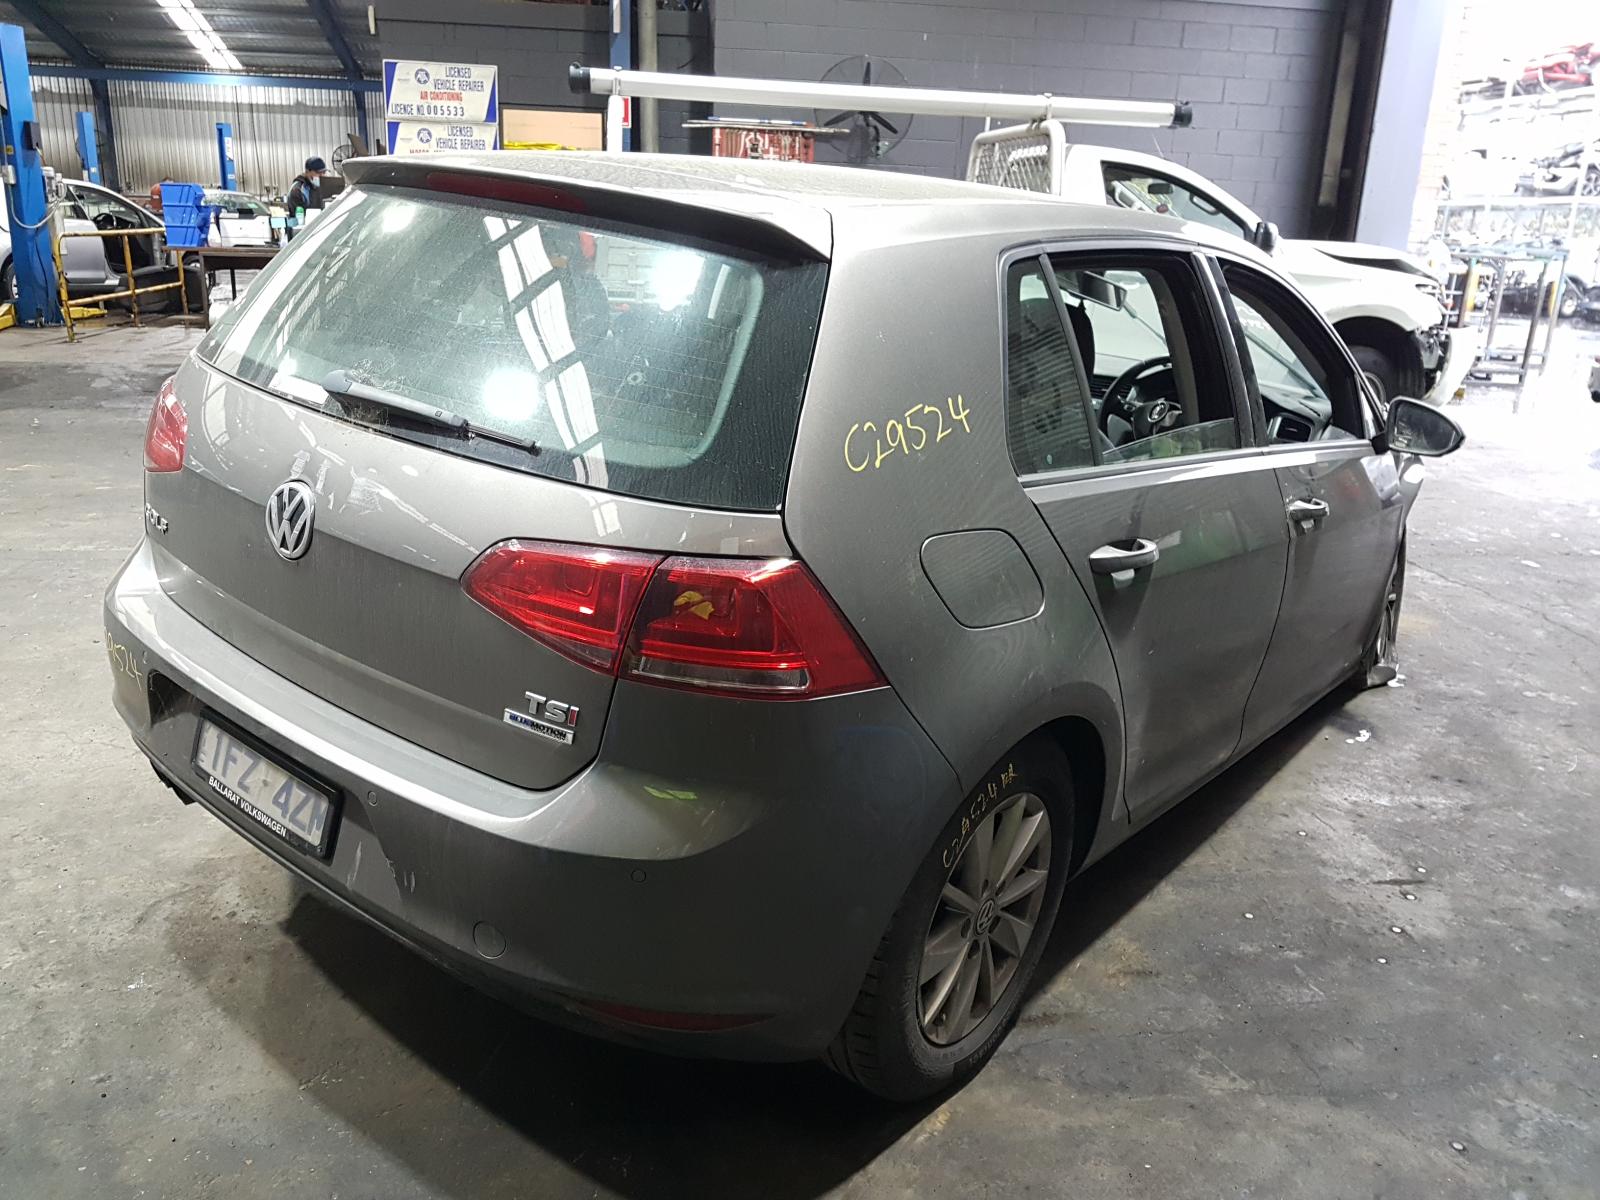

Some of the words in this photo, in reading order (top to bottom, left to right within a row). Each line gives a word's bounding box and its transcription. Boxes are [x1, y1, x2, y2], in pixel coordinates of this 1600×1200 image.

[445, 66, 472, 79] LICENSED
[433, 79, 456, 91] VEHICLE
[458, 81, 485, 92] REPAIRER
[419, 91, 429, 101] AIR
[430, 91, 463, 102] CONDITIONING
[391, 103, 414, 116] LICENCE
[426, 104, 465, 117] 005533
[447, 125, 474, 138] LICENSED
[435, 138, 458, 150] VEHICLE
[460, 139, 486, 151] REPAIRER
[844, 394, 970, 472] C29524
[509, 712, 567, 739] BLUEMOTION
[208, 775, 241, 806] BALLARAT
[240, 799, 287, 838] VOLKSWAGEN
